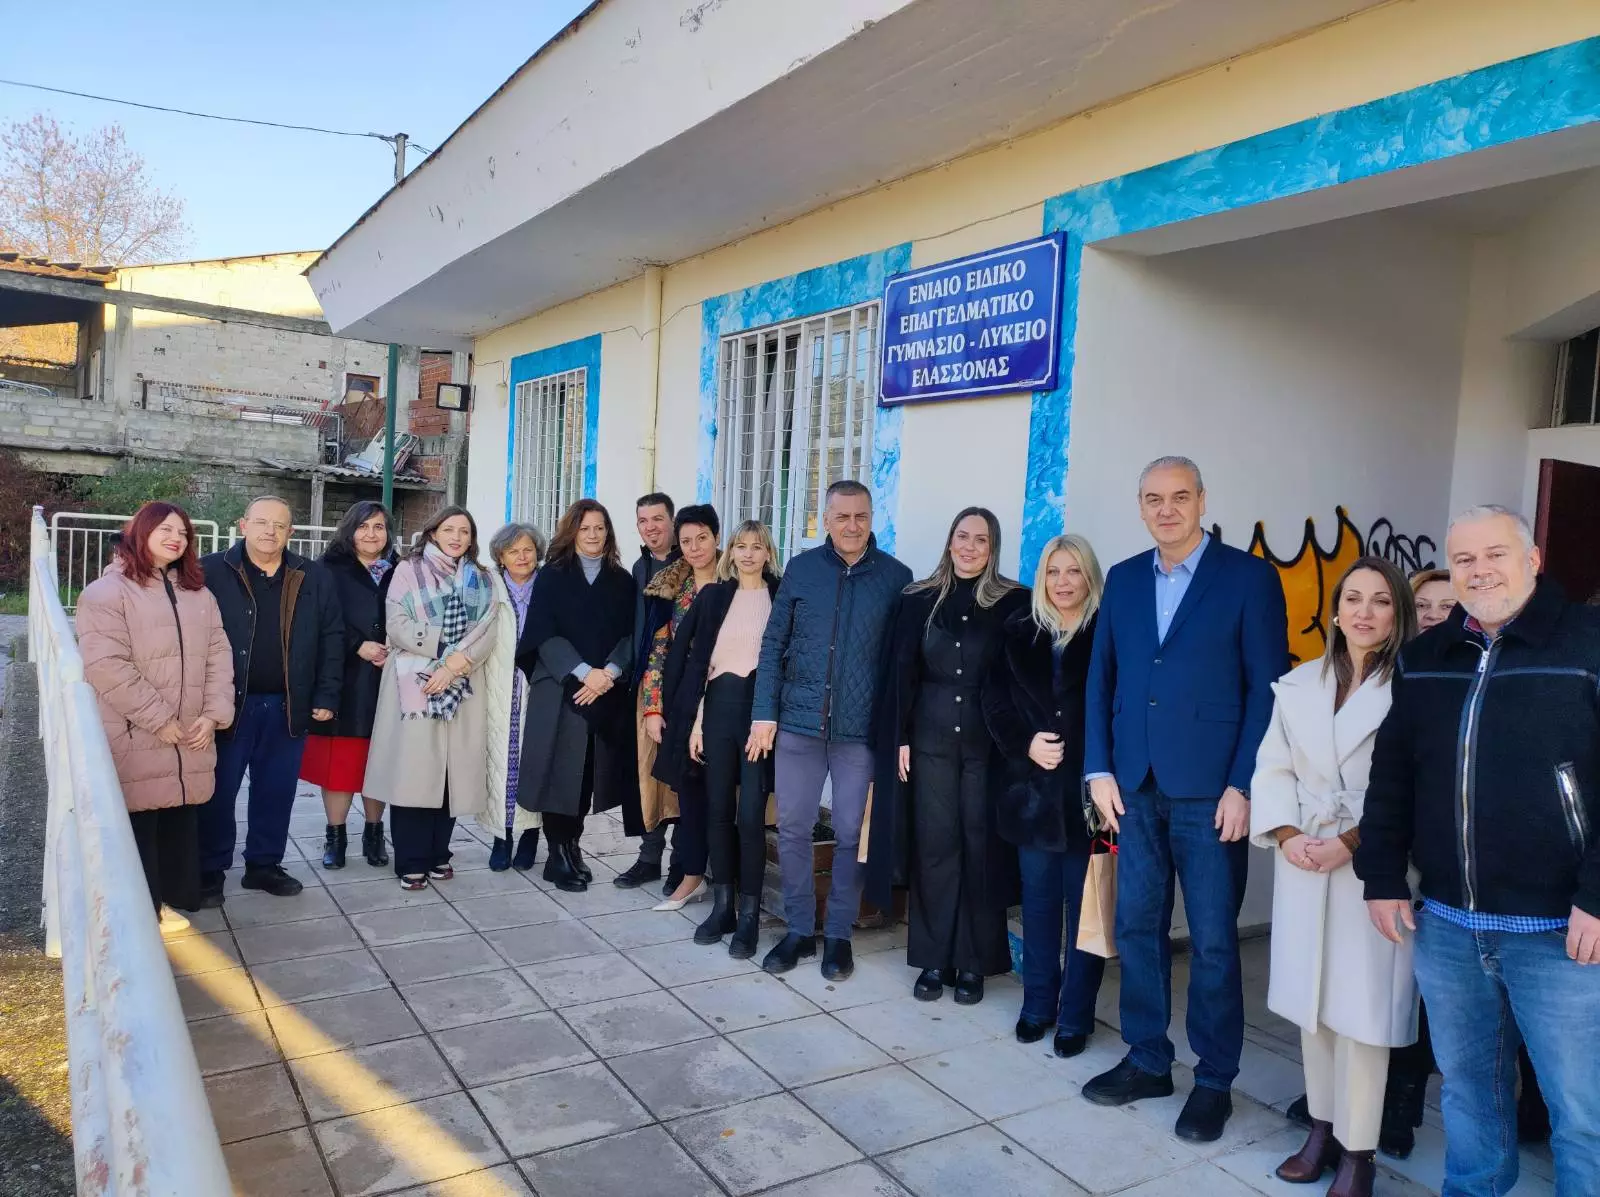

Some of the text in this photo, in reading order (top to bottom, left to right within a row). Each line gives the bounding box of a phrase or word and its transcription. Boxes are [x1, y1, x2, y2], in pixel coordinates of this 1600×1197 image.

[909, 259, 1026, 304] ΕΝΙΑΙΟ ΕΙΔΙΚΟ
[900, 290, 1034, 334] ΕΠΑΓΓΕΛΜΑΤΙΚΟ
[887, 333, 965, 363] ΓΥΜΝΑΣΙΟ
[979, 318, 1046, 349] ΛΥΚΕΙΟ
[911, 355, 1009, 387] ΕΛΑΣΣΟΝΑΣ
